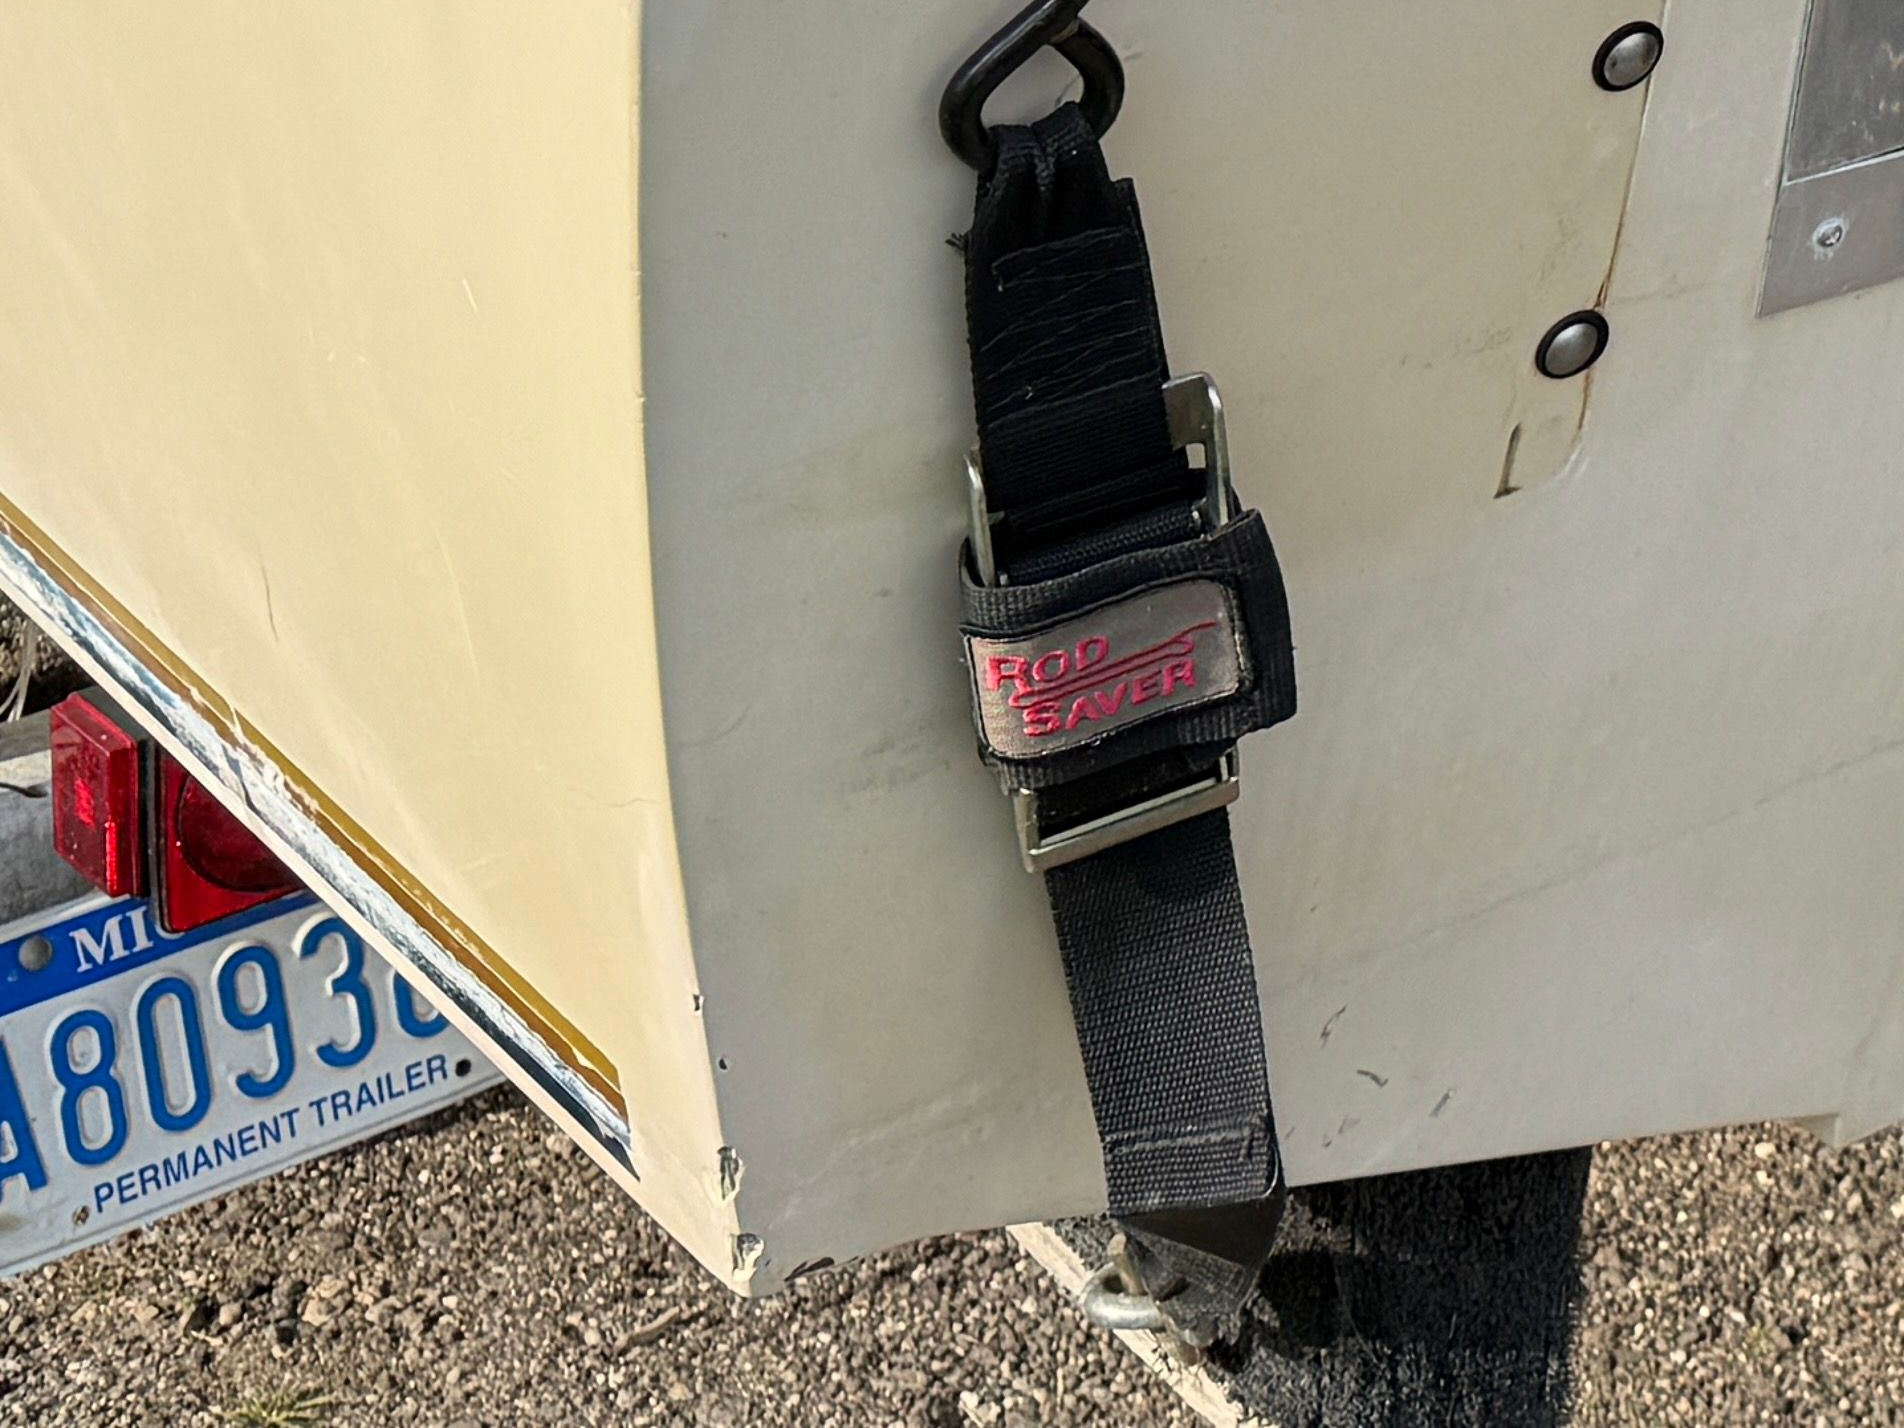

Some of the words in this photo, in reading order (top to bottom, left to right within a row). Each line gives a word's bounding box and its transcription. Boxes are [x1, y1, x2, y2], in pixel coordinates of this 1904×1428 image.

[984, 635, 1110, 696] ROD
[1023, 657, 1196, 736] SAVER
[94, 1107, 301, 1212] PERMANENT
[309, 1054, 447, 1127] TRAILER
